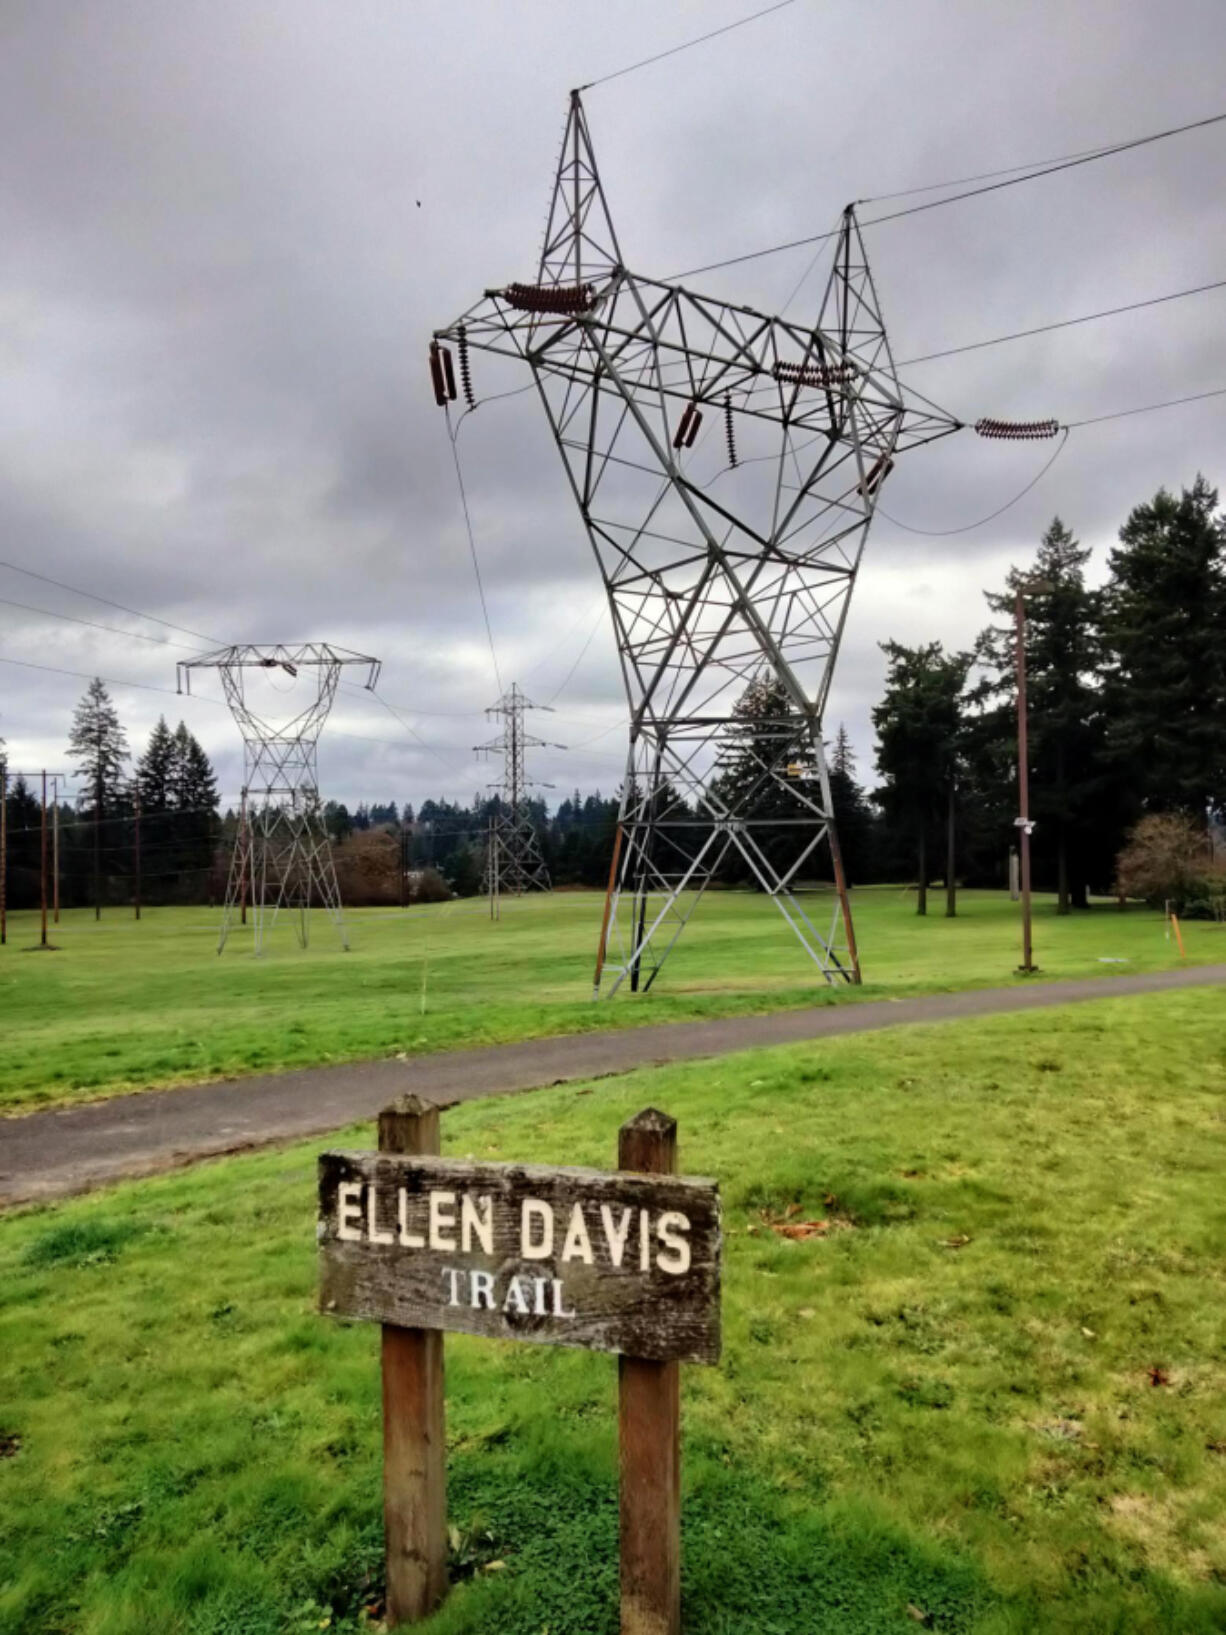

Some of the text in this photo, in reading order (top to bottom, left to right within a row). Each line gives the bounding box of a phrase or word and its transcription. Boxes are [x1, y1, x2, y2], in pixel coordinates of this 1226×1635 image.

[337, 1183, 691, 1274] ELLEN DAVIS
[441, 1268, 576, 1318] TRAIL
